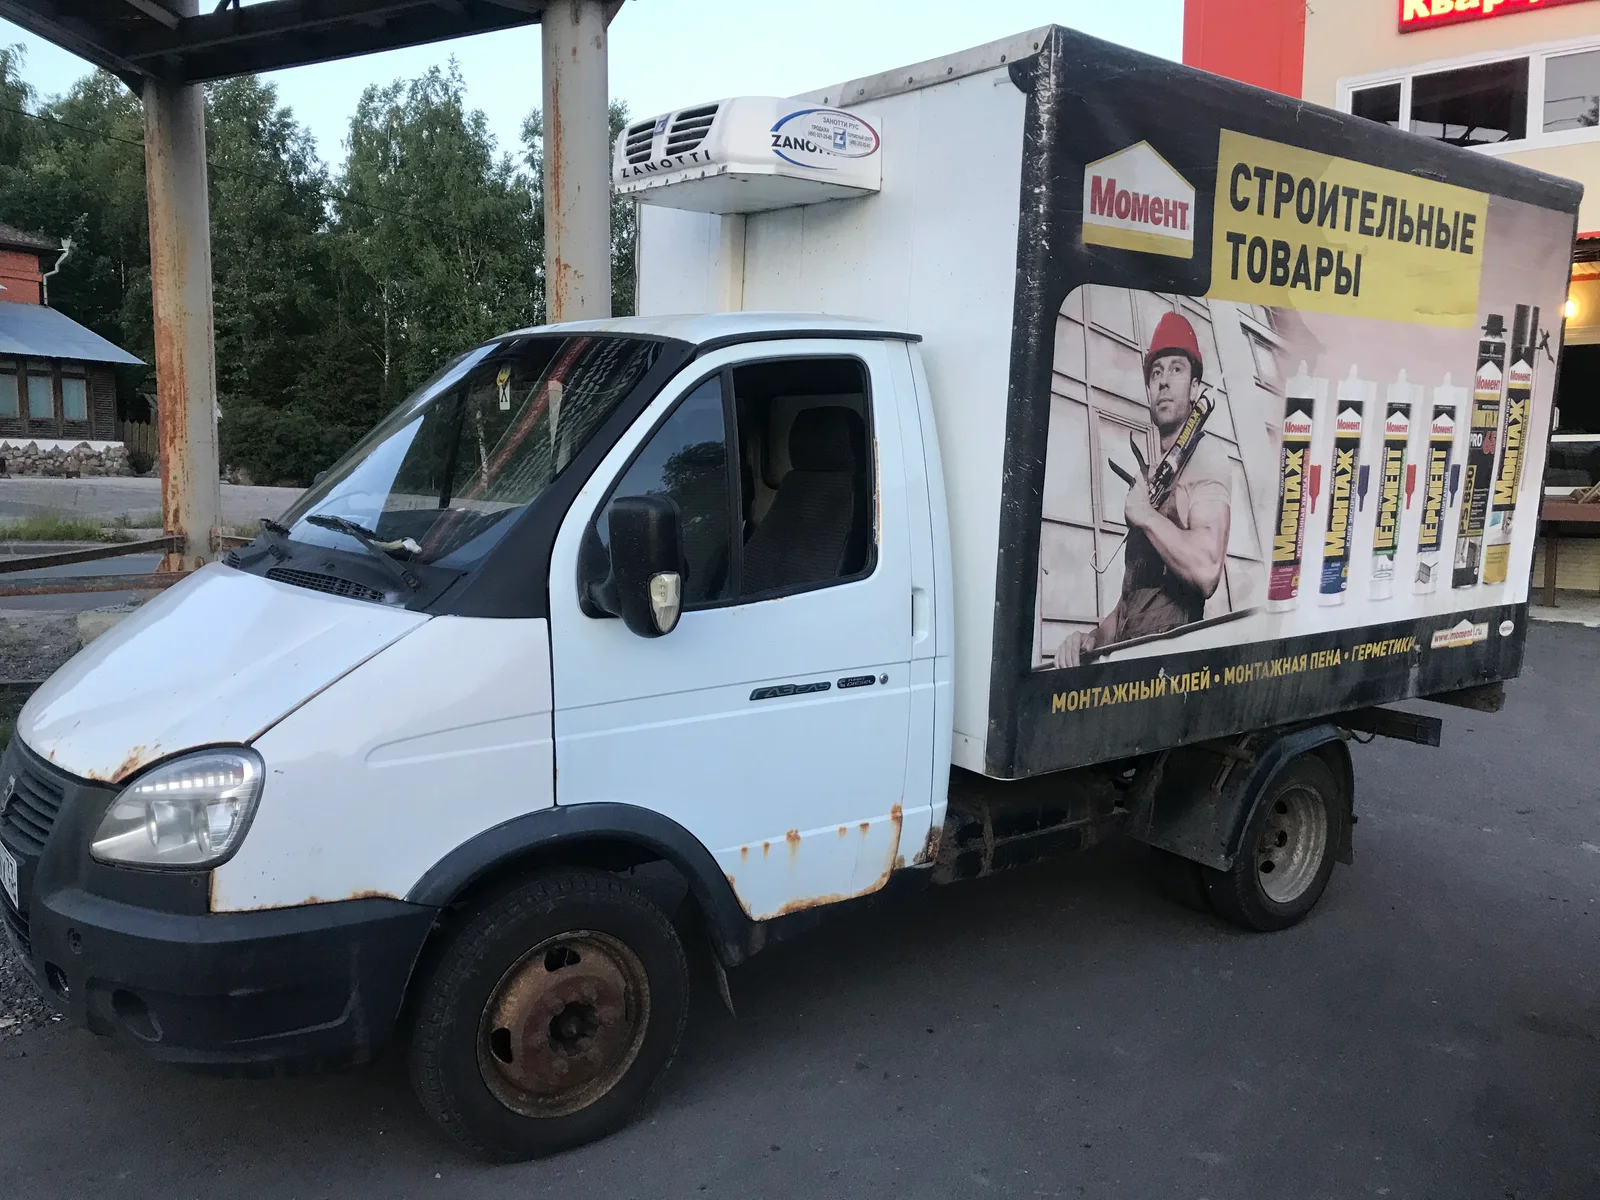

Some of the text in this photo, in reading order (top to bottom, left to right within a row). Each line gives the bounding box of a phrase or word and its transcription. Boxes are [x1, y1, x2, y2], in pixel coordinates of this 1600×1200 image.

[822, 116, 848, 128] ЗАНОТТИ
[771, 134, 837, 157] ZANO
[620, 149, 711, 178] ZANOTTI
[1089, 174, 1189, 231] Момент
[1228, 161, 1477, 255] СТРОИТЕЛЬНЫЕ
[1226, 230, 1363, 298] ТОВАРЫ
[1284, 421, 1311, 433] Момент
[1337, 419, 1360, 430] Момент
[1052, 674, 1166, 714] МОНТАЖНЫЙ
[1170, 666, 1210, 695] КЛЕЙ
[1223, 654, 1308, 685] МОНТАЖНАЯ
[1310, 649, 1341, 670] ПЕНА
